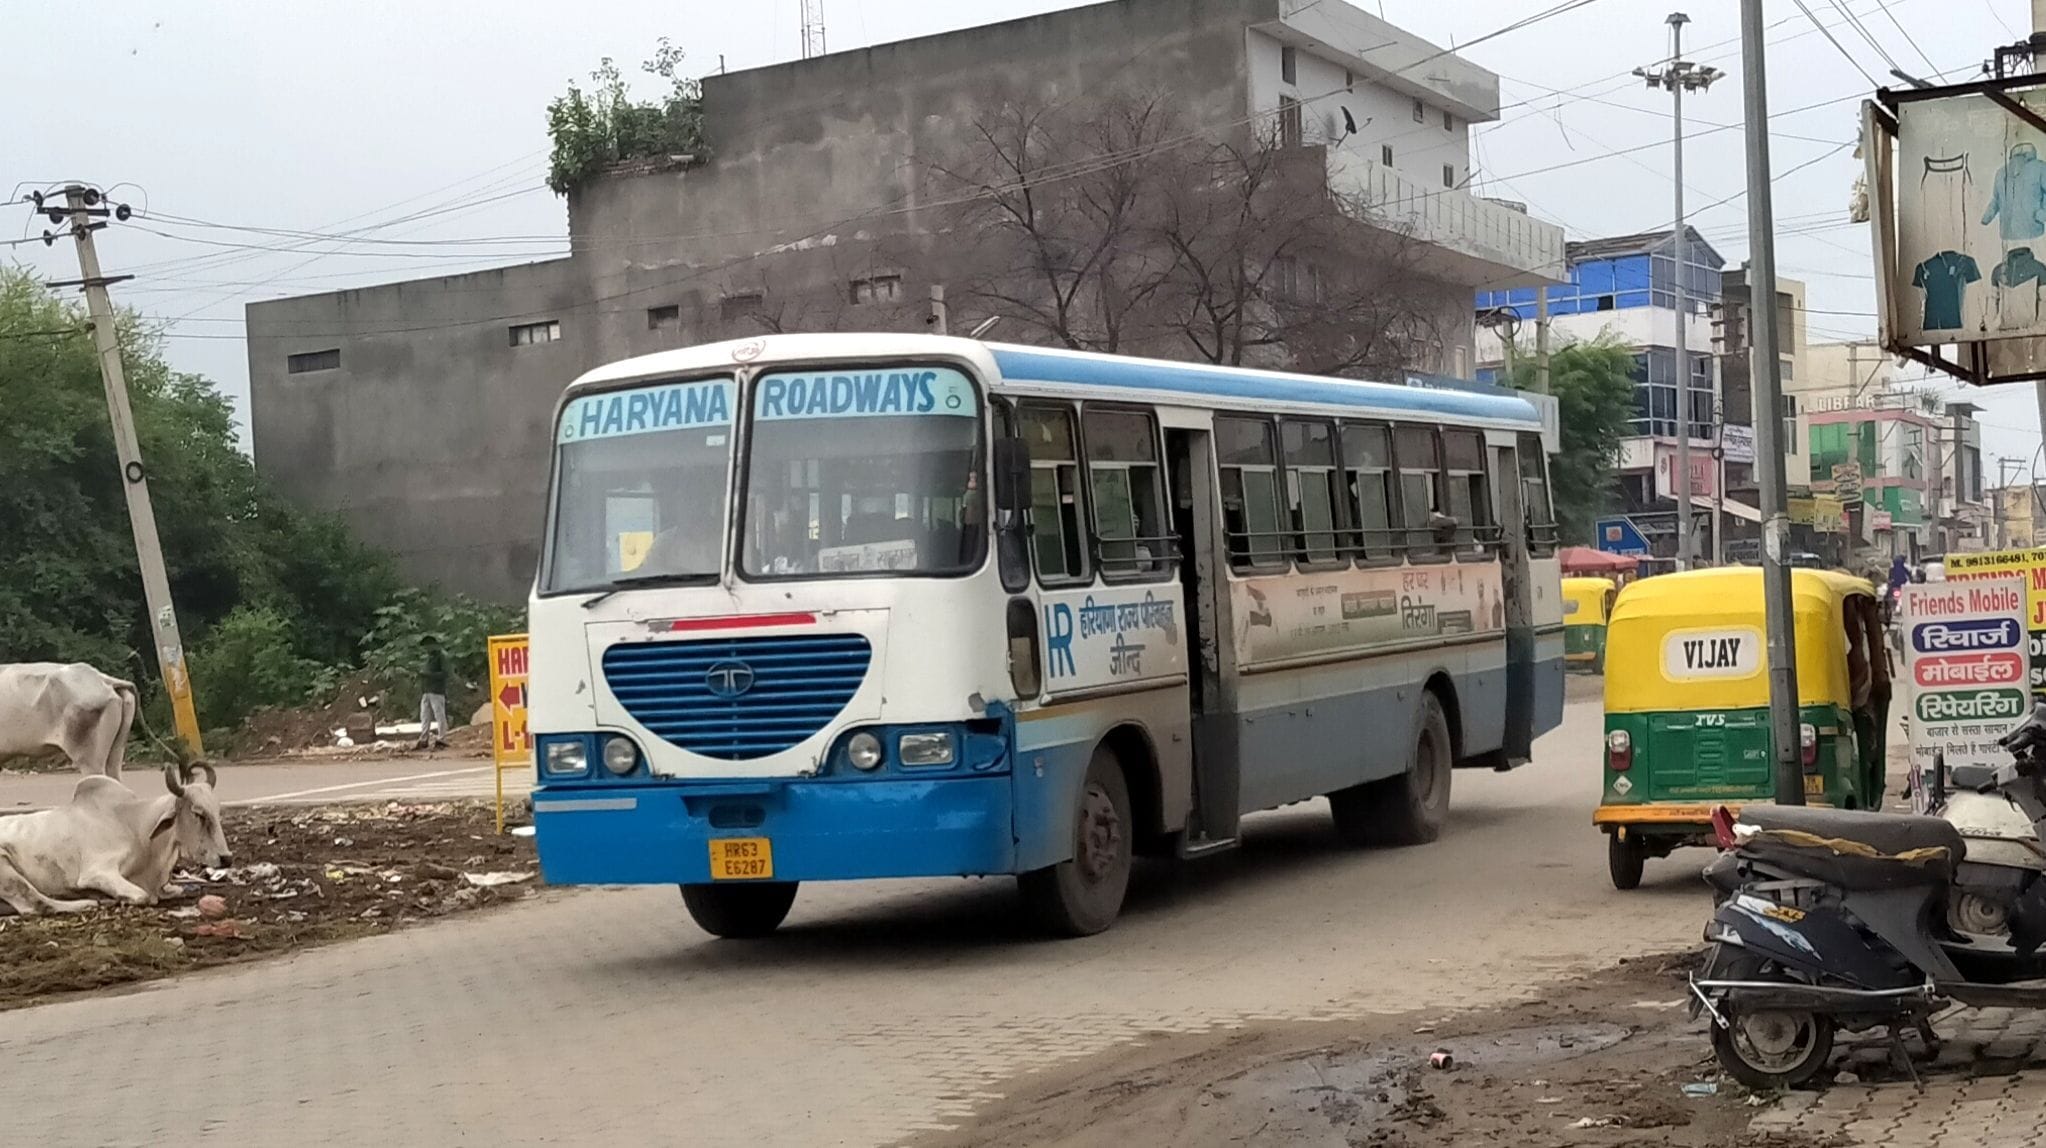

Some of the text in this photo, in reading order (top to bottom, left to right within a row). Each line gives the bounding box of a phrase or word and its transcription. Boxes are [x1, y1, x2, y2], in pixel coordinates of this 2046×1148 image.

[579, 371, 937, 437] HARYANA ROADWAYS
[1401, 595, 1435, 629] तिरंगा
[1910, 586, 2019, 617] Friends Mobile
[1921, 621, 2011, 649] रिचार्ज
[1110, 632, 1146, 676] जीन्द
[1683, 637, 1741, 669] VIJAY
[1921, 655, 2015, 682] मोबाईल
[1919, 690, 2019, 719] रिपेयरिंग
[1695, 714, 1726, 727] TVS
[724, 841, 759, 857] HR63
[724, 859, 766, 875] E6287
